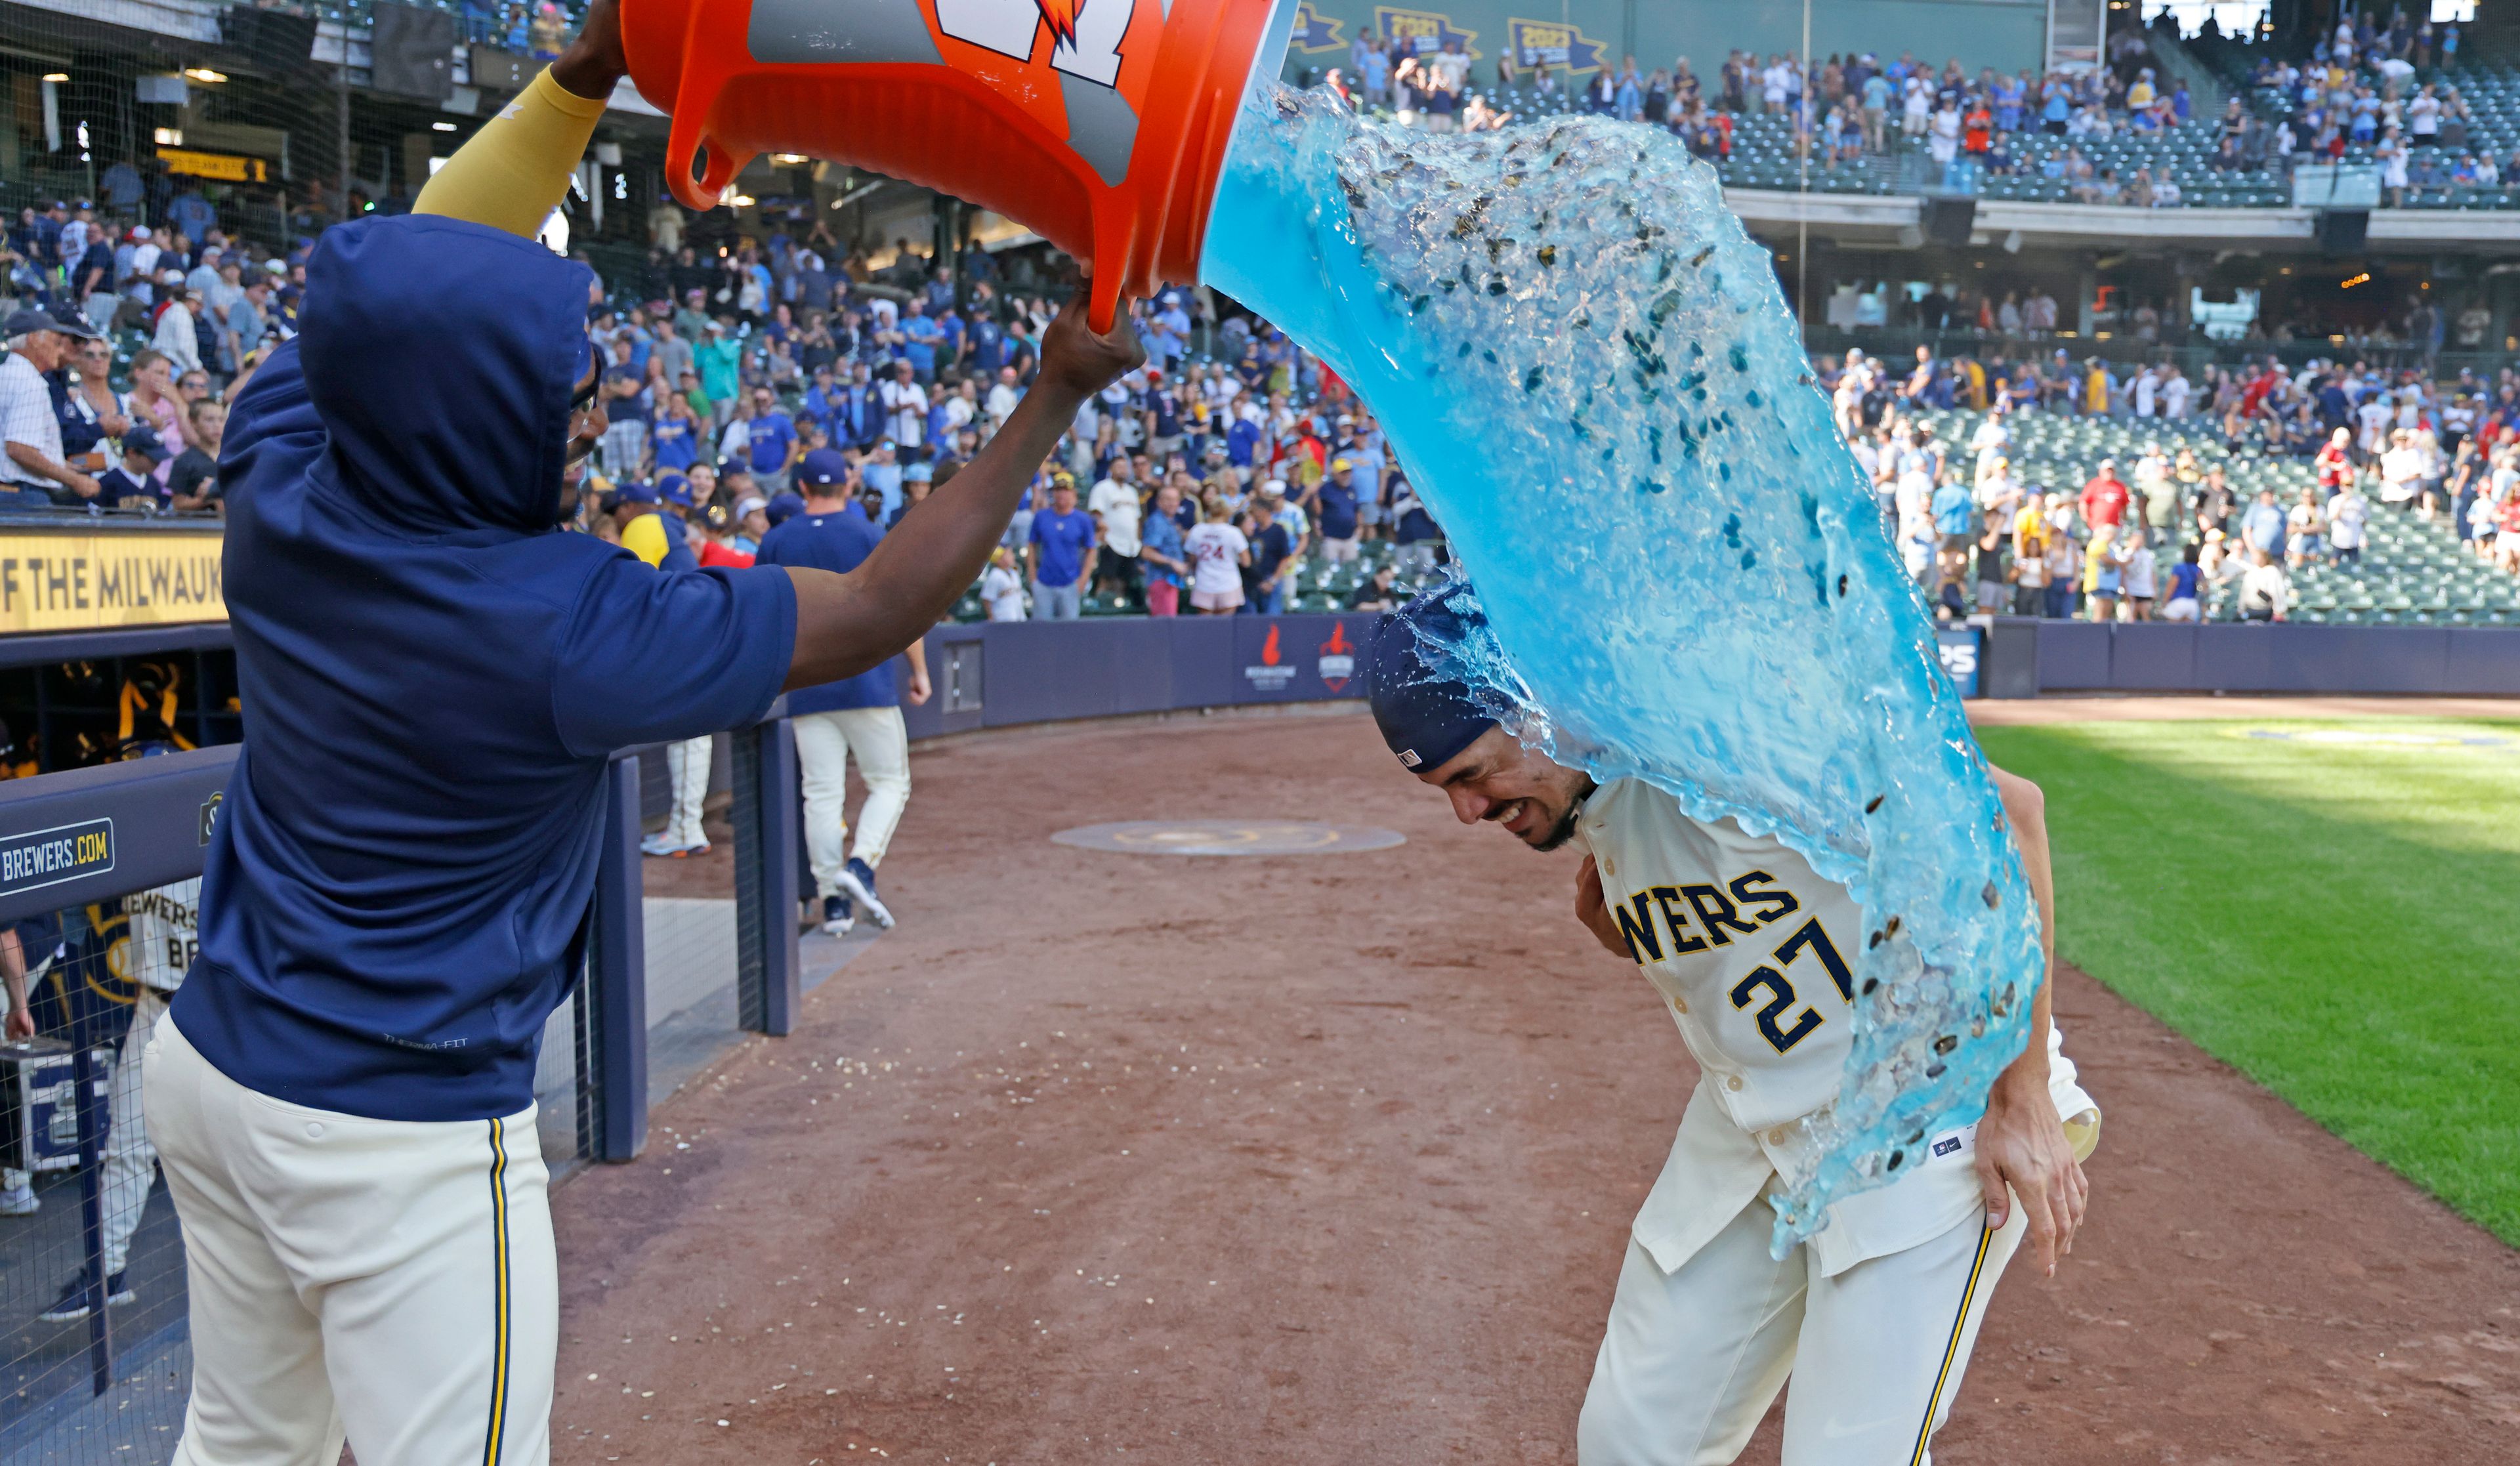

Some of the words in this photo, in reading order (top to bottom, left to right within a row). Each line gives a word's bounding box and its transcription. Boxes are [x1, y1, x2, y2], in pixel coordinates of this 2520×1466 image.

[1199, 542, 1225, 562] 24
[0, 558, 19, 612] F
[28, 558, 89, 611] THE
[3, 831, 108, 882] BREWERS.COM
[1727, 914, 1853, 1057] 27
